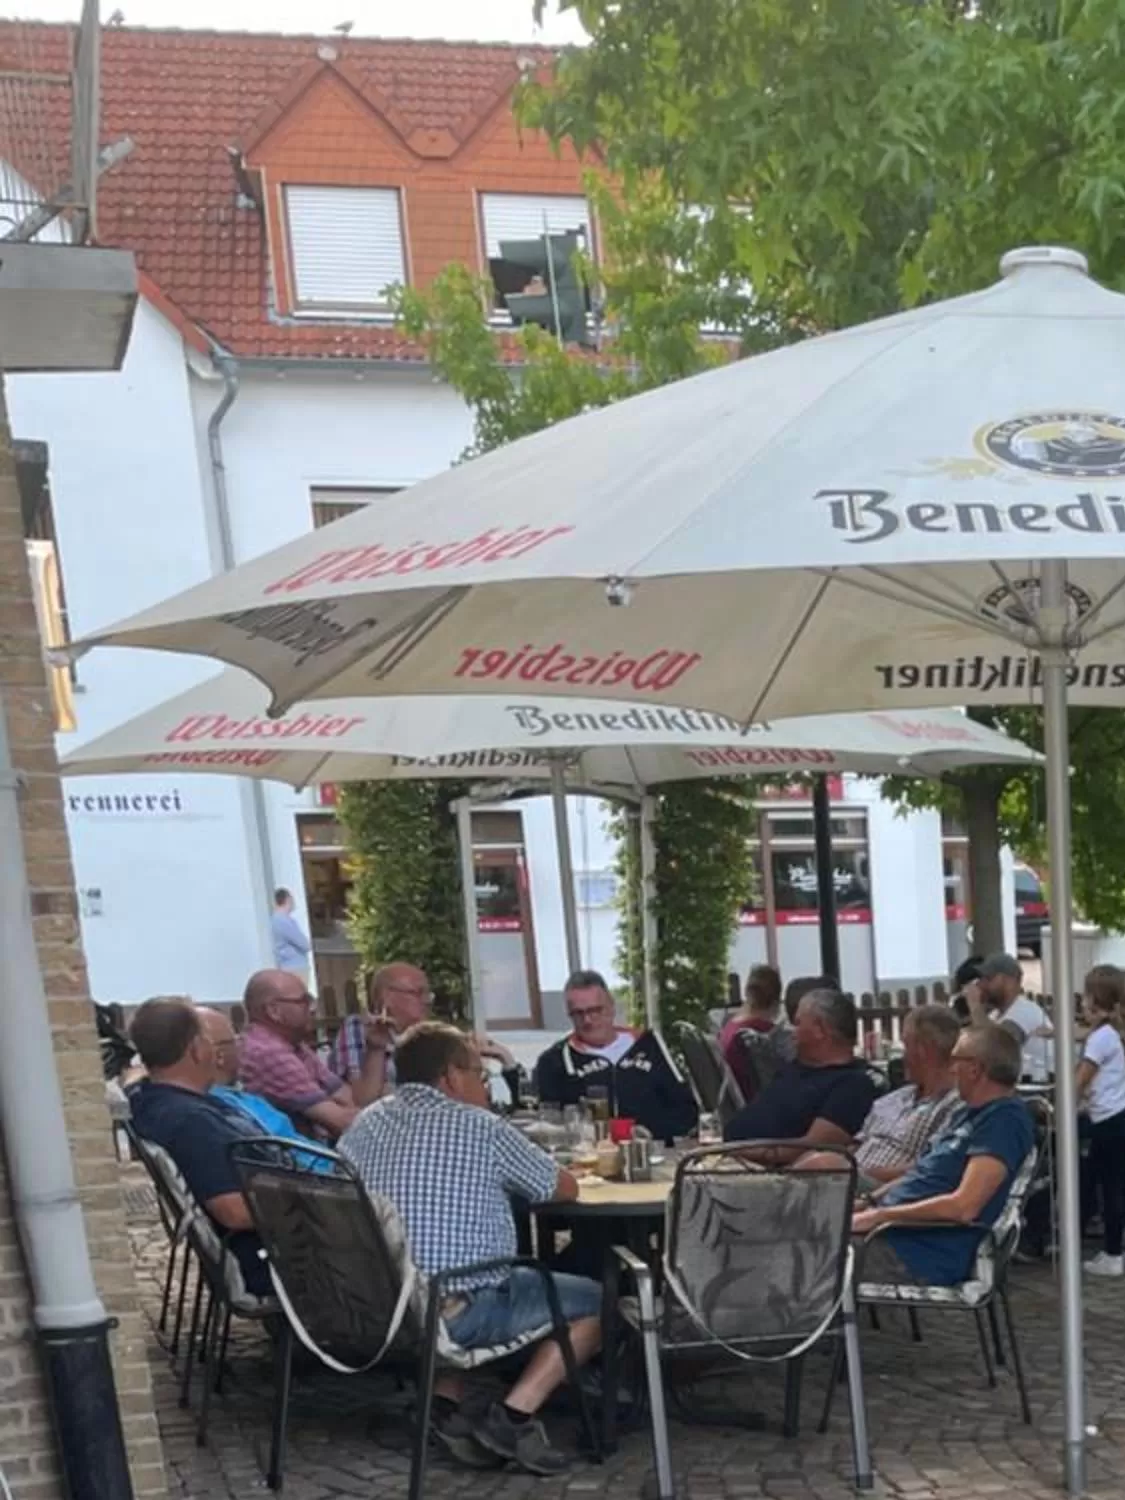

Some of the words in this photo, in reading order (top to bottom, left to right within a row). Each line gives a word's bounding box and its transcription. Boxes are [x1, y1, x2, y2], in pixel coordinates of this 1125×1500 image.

[264, 525, 574, 595] Weissbier
[164, 713, 366, 743] Weissbier
[505, 704, 774, 737] Benediktinr
